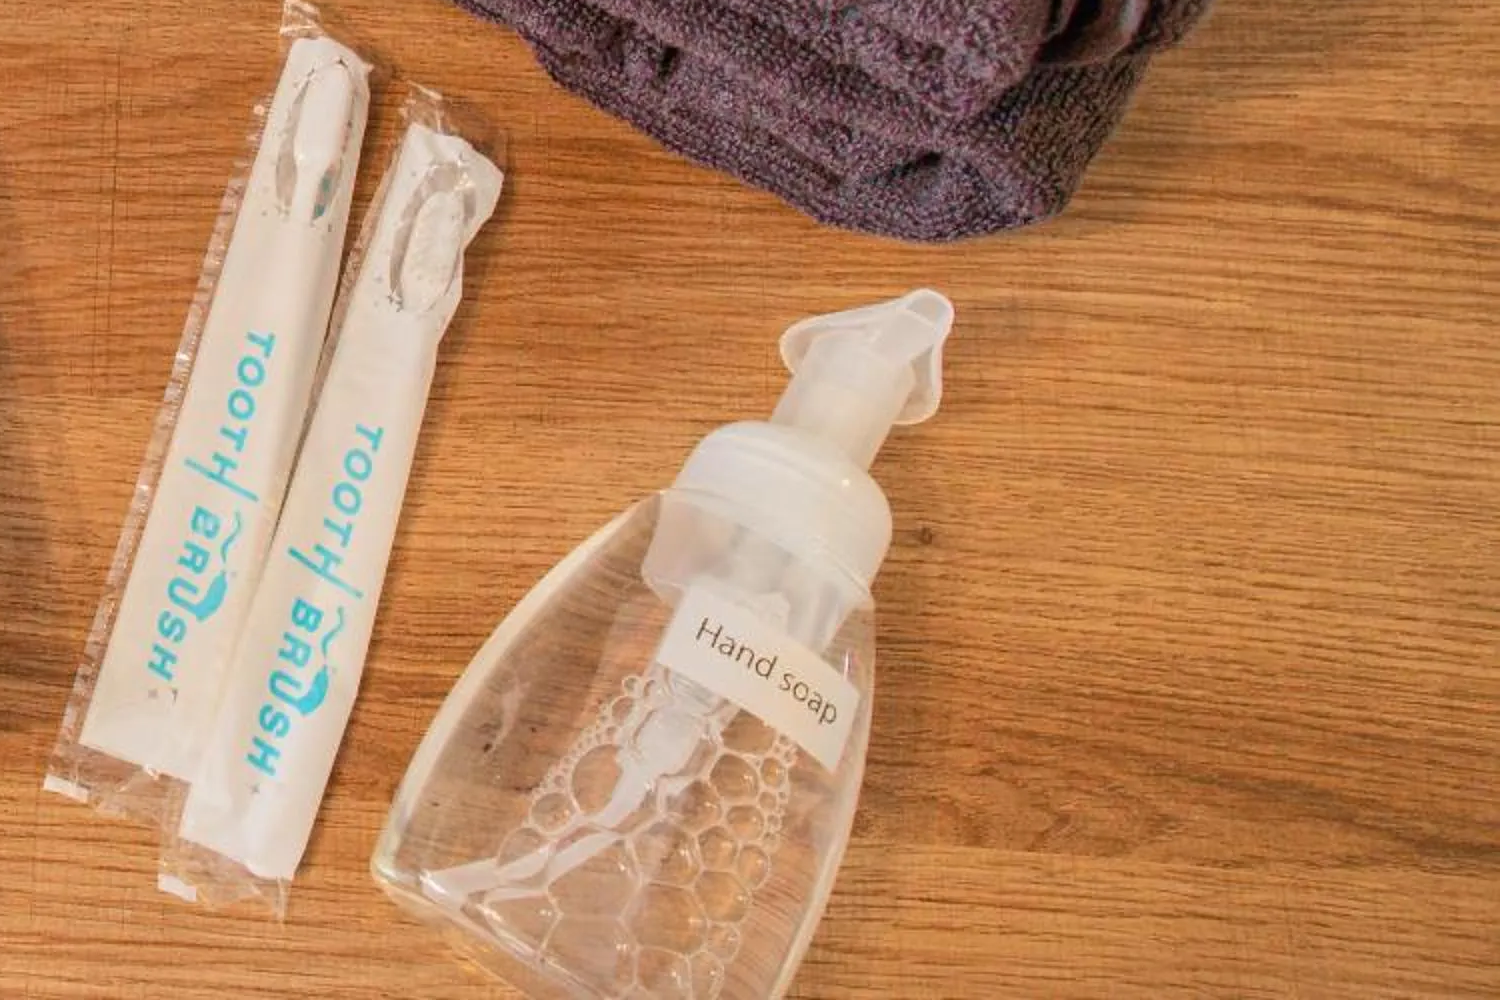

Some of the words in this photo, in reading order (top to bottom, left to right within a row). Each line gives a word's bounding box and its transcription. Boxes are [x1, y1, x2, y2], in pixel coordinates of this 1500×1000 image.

[184, 332, 275, 502] TOOTH
[147, 505, 228, 682] BRUSH
[288, 423, 385, 599] TOOTH
[245, 597, 329, 777] BRUSH
[695, 617, 778, 680] Hand
[778, 673, 838, 726] soap
